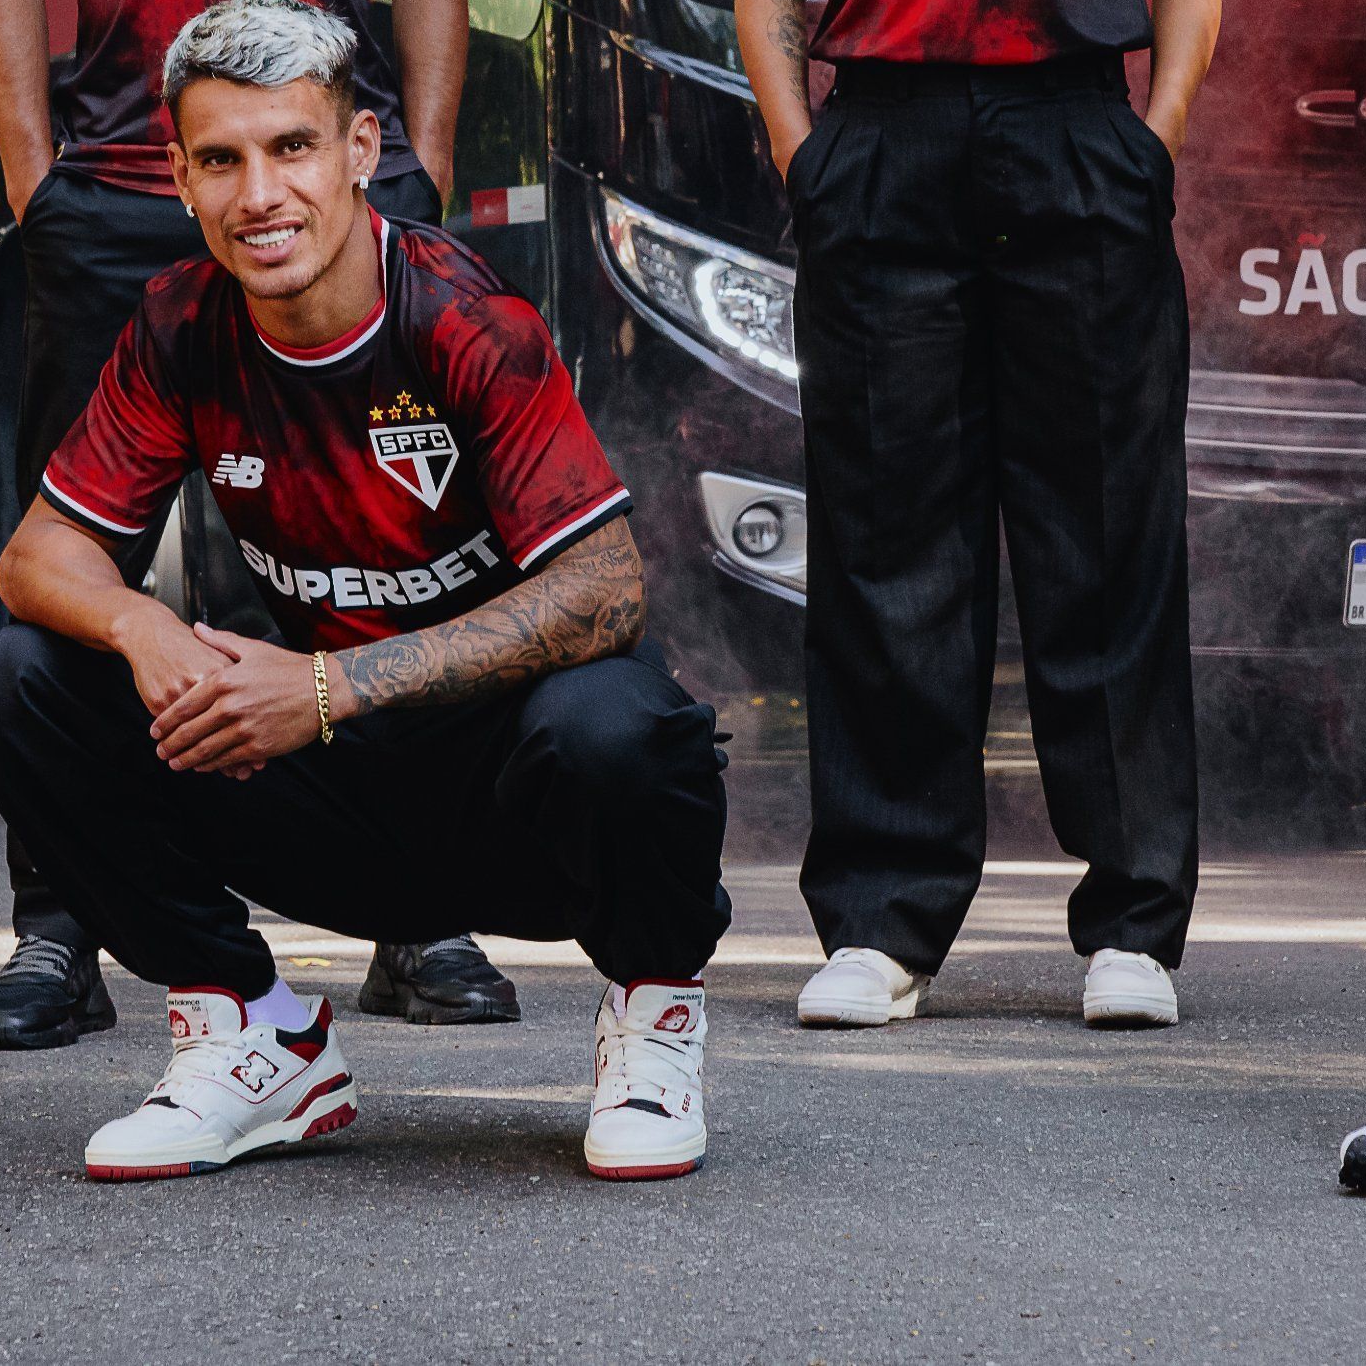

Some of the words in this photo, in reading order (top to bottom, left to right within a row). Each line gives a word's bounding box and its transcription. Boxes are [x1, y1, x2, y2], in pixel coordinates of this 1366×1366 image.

[380, 429, 447, 454] SPFC
[238, 529, 503, 608] SUPERBET
[1351, 605, 1366, 619] BR
